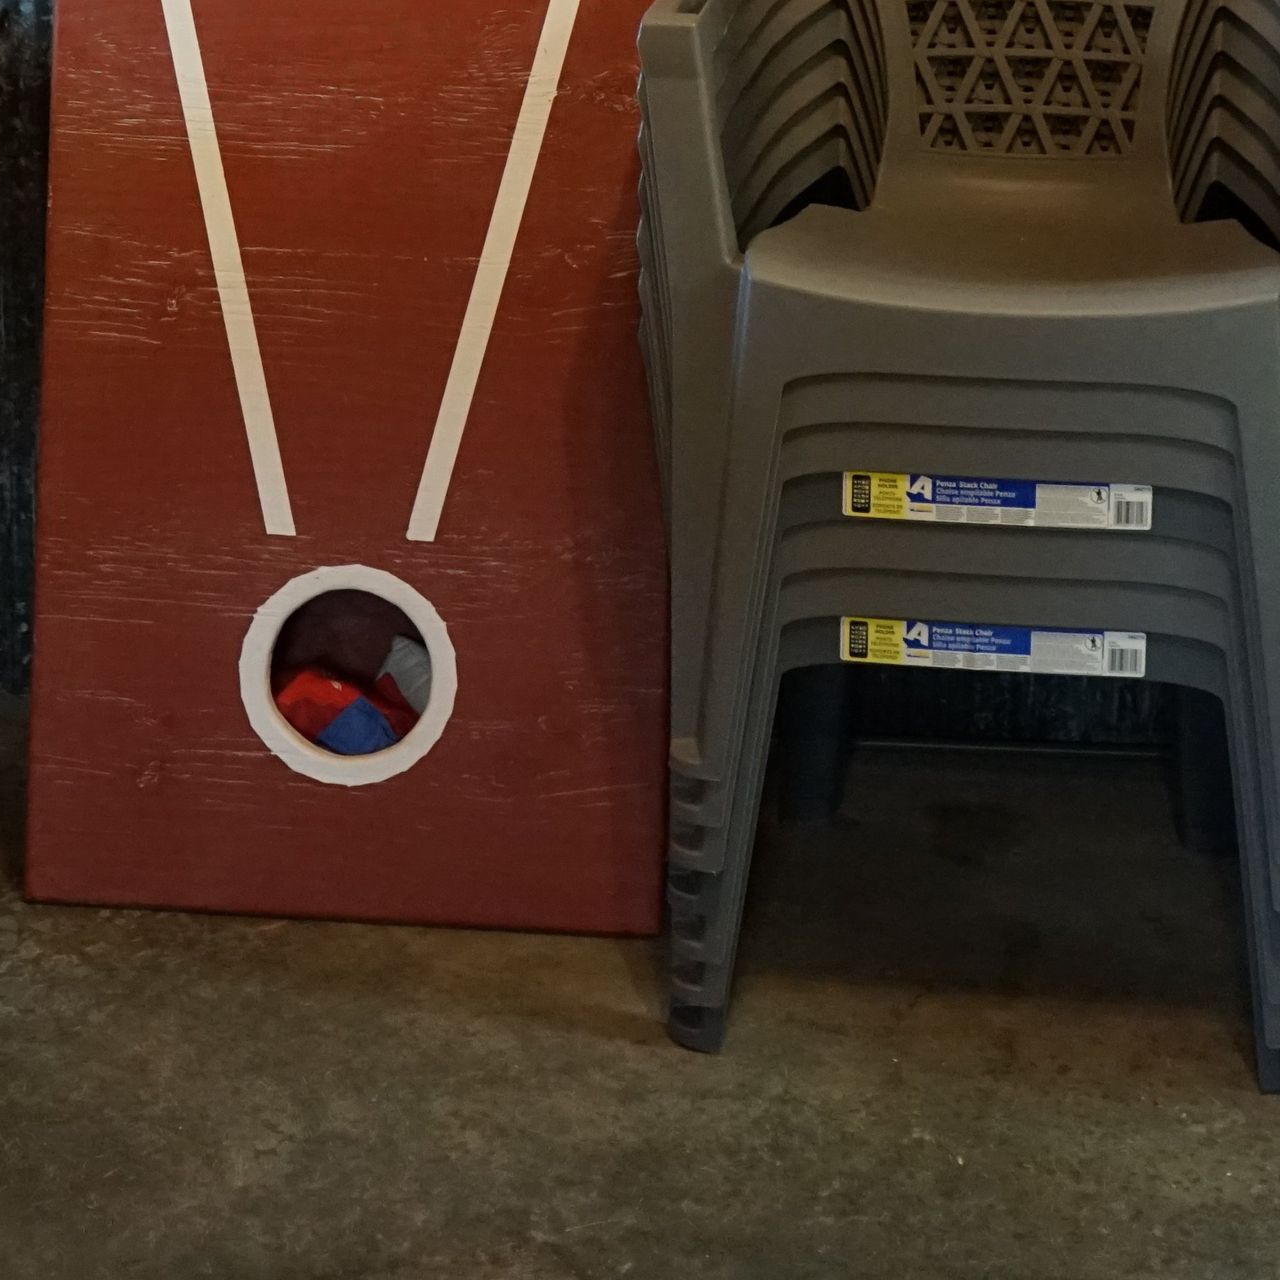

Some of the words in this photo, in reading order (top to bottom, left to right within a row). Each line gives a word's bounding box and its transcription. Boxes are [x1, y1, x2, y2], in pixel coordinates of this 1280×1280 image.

[935, 479, 956, 488] Penza
[959, 480, 978, 489] Stack
[980, 481, 998, 490] Chair
[955, 627, 974, 635] Stack
[975, 628, 993, 637] Chair
